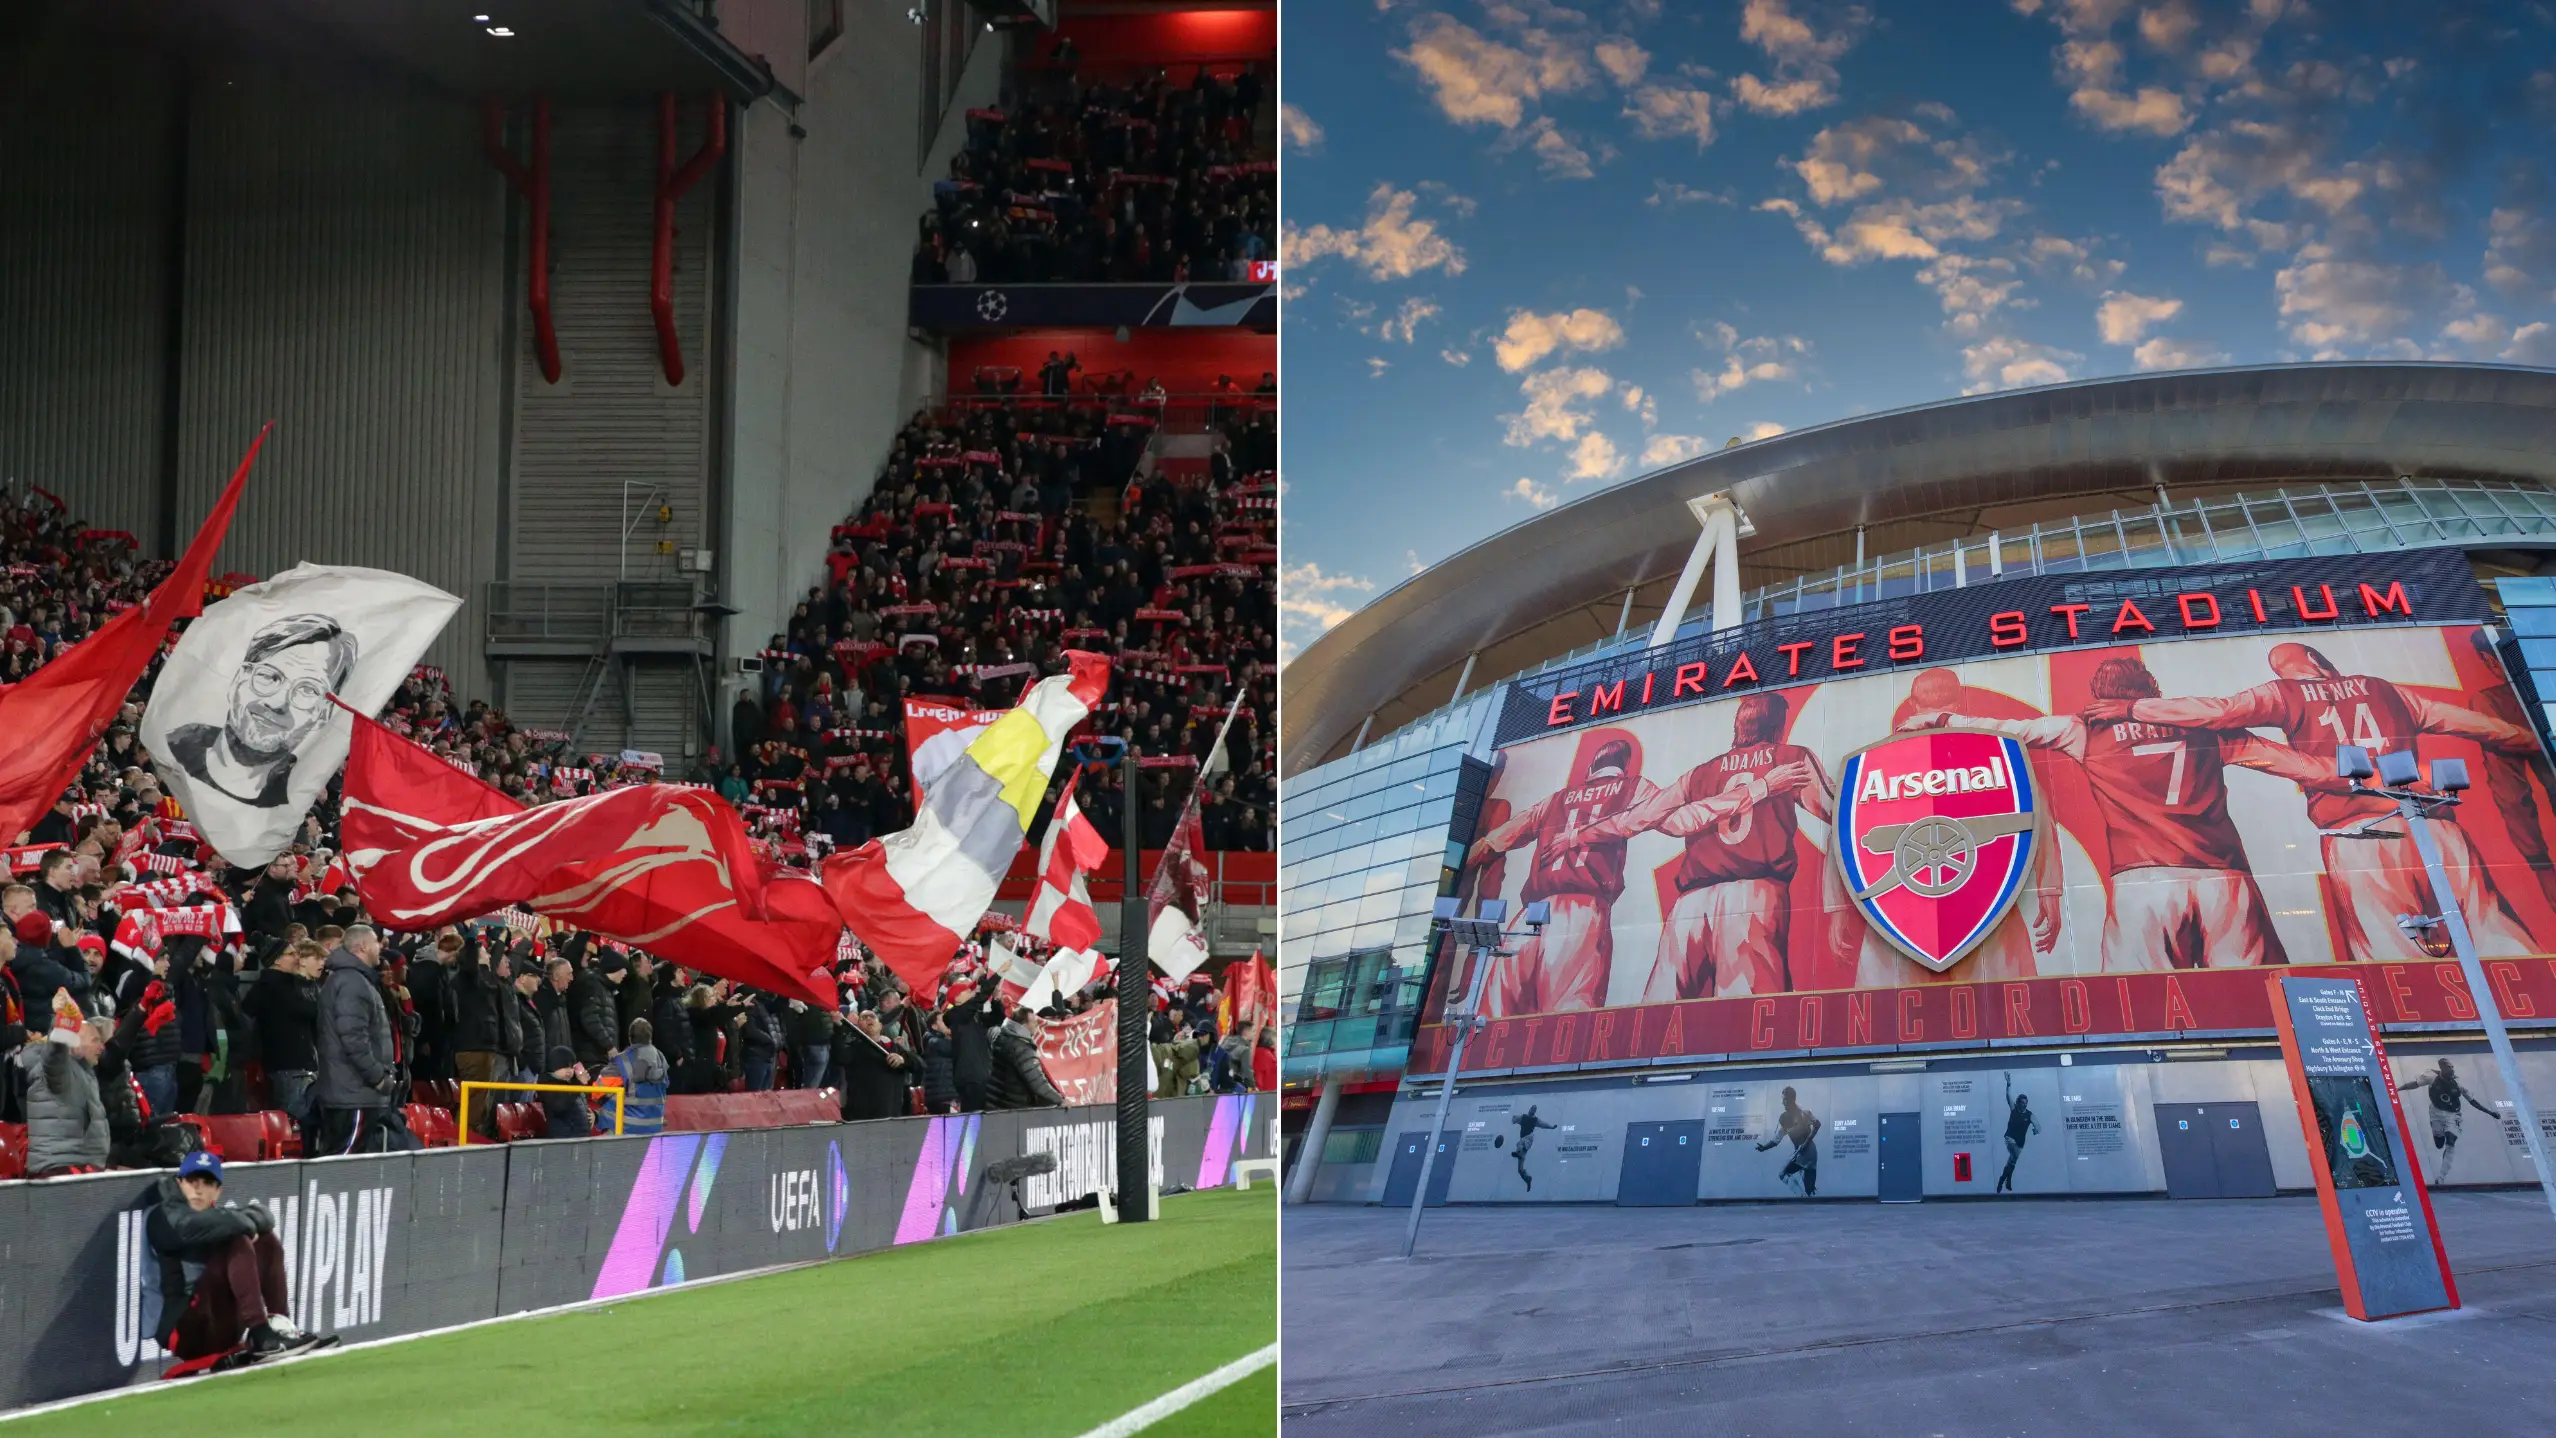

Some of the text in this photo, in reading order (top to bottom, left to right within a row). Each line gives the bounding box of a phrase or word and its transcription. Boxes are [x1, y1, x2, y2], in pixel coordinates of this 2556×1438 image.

[1547, 580, 2414, 727] EMIRATES STADIUM
[2300, 679, 2370, 702] HENRY
[2318, 703, 2390, 755] 14
[1720, 748, 1774, 773] ADAMS
[1859, 756, 2009, 802] Arsenal
[2132, 740, 2187, 805] 7
[1565, 780, 1624, 804] BASTIN
[1430, 962, 2556, 1073] VICTORIA CONCORDIA ESC
[2356, 979, 2376, 1031] STADIUM
[2332, 1056, 2352, 1064] Armoury
[2375, 1041, 2398, 1104] EMIRATES
[771, 1169, 821, 1233] UEFA
[2366, 1209, 2378, 1217] CCTV
[2385, 1208, 2408, 1216] operation
[115, 1179, 394, 1367] UM/PLAY
